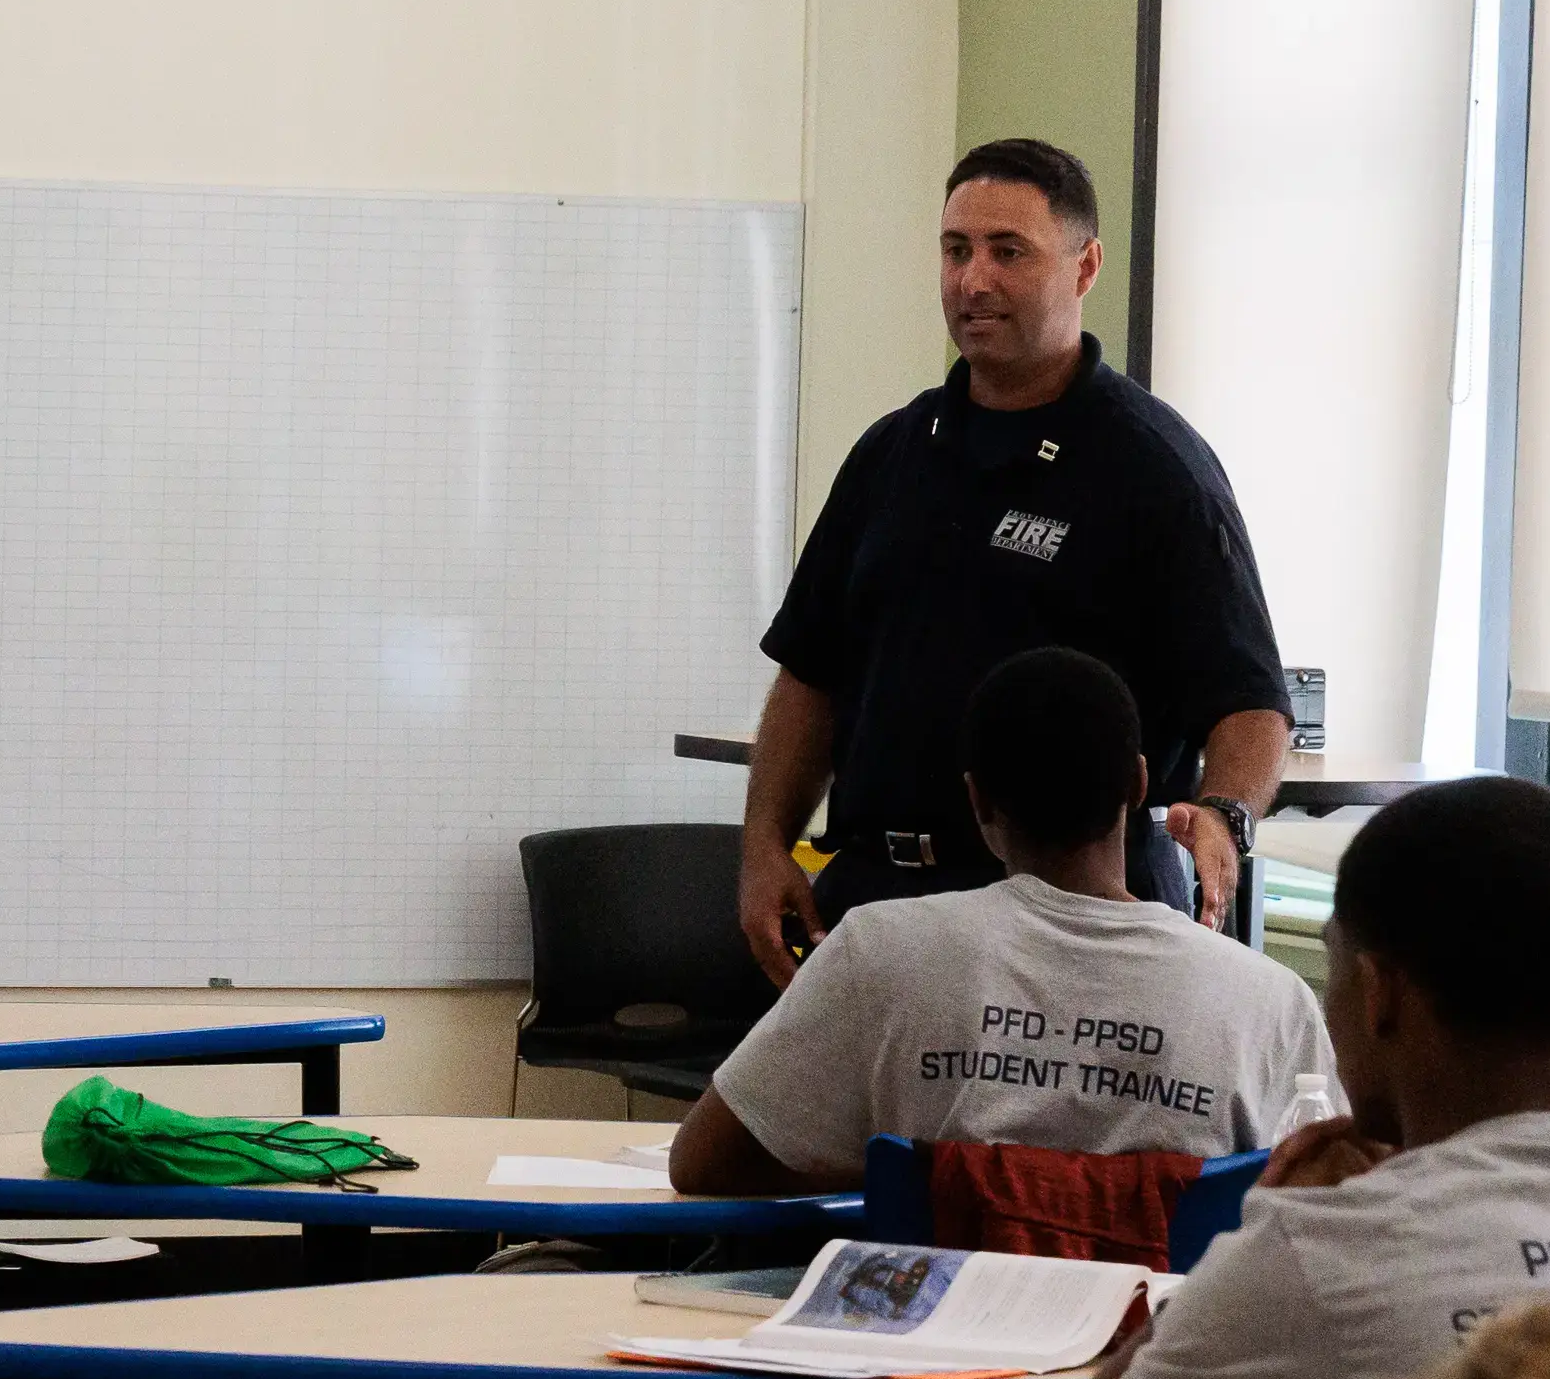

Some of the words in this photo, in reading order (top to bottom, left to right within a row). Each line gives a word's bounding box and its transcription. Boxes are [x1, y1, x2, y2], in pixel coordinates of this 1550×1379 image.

[994, 516, 1068, 552] FIRE
[981, 1005, 1046, 1042] PFD
[1072, 1017, 1165, 1057] PPSD
[921, 1051, 1070, 1090] STUDENT
[1079, 1063, 1215, 1117] TRAINEE
